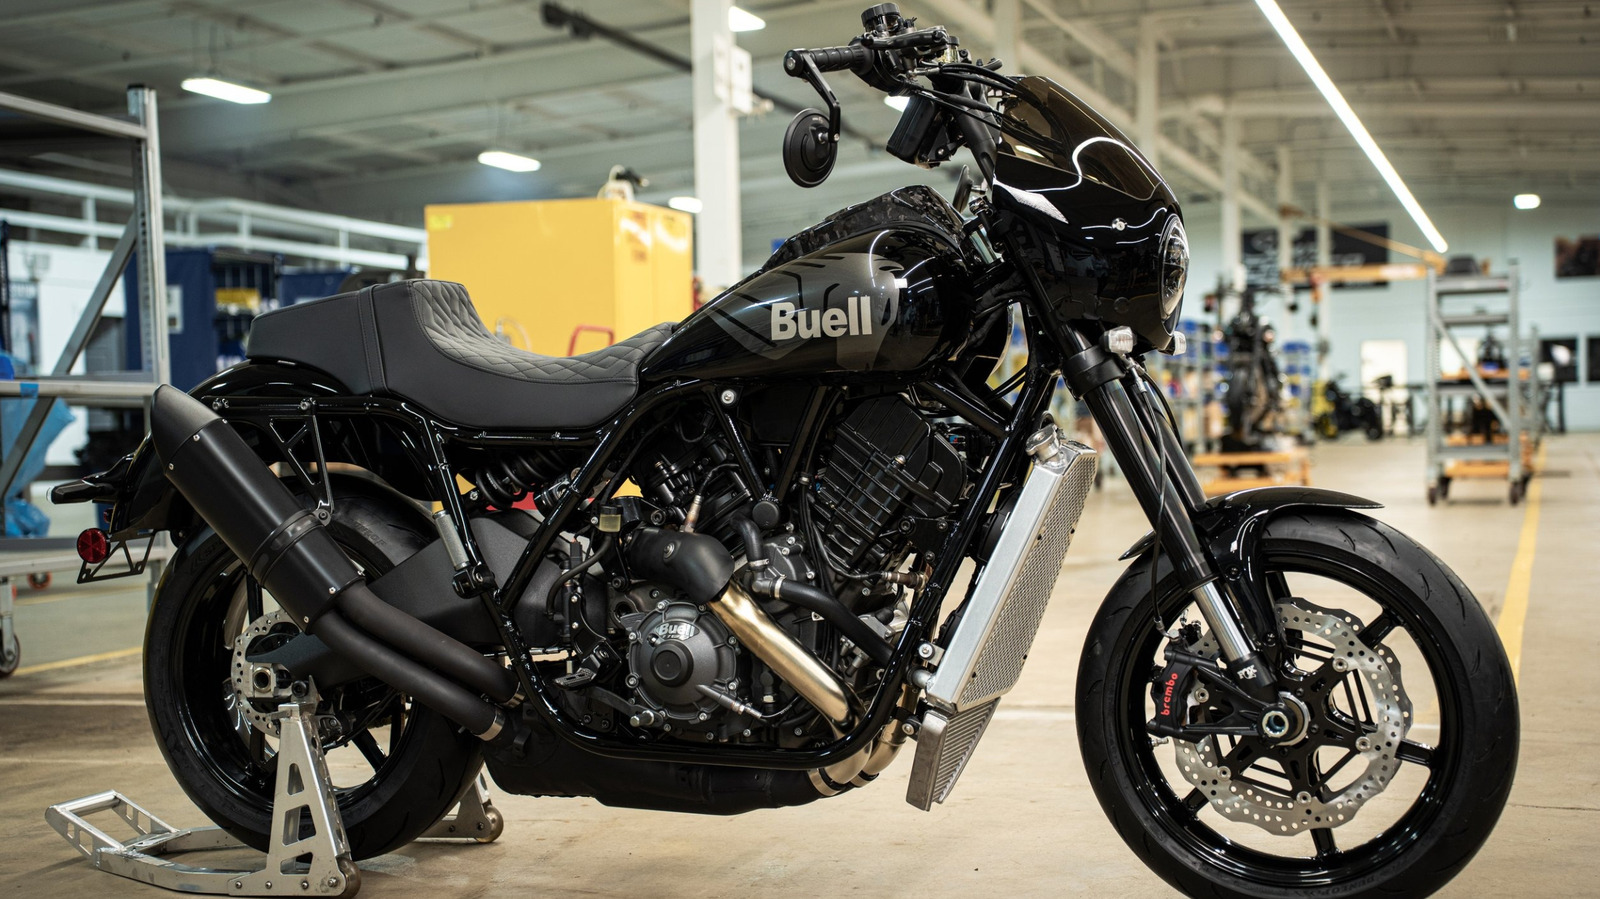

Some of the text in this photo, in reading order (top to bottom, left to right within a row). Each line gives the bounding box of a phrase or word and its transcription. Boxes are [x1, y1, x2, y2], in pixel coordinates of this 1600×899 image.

[771, 295, 872, 341] Buell
[659, 622, 695, 638] Buell
[1237, 664, 1258, 680] FOX
[1160, 672, 1178, 716] brembo
